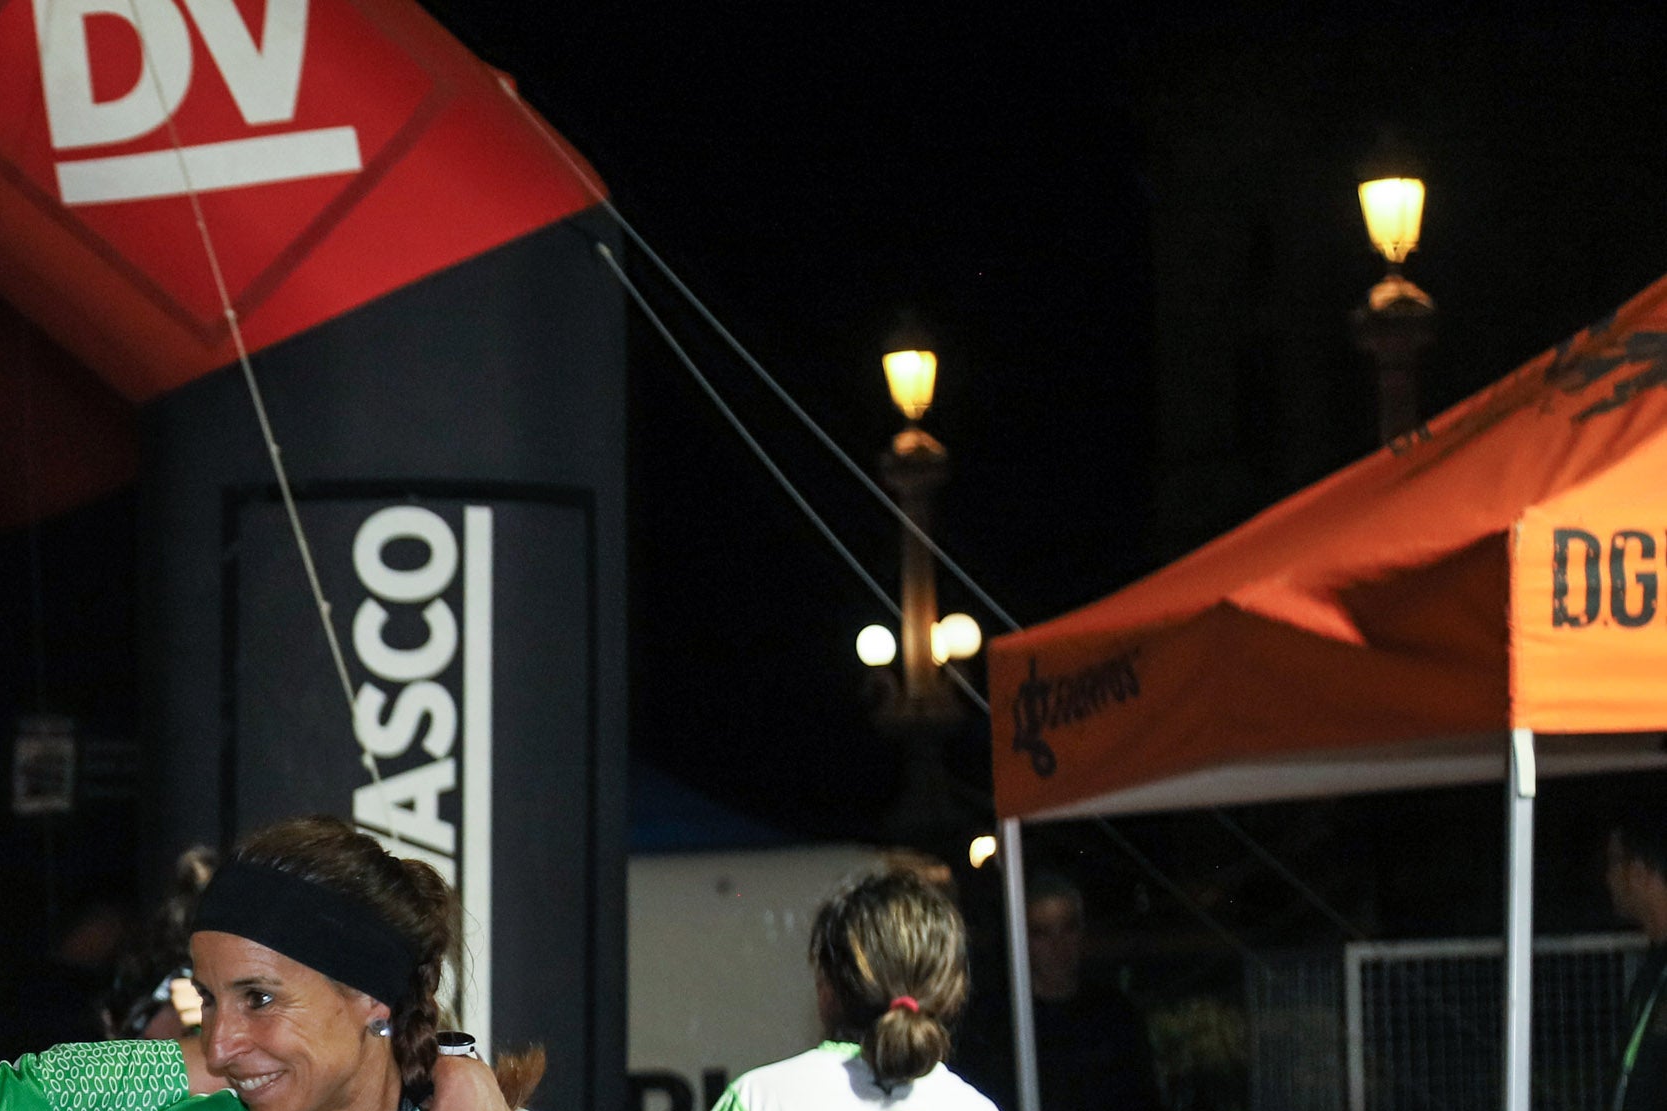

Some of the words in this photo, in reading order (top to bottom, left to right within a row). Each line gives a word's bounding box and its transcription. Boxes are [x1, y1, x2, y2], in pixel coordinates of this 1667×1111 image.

[34, 0, 310, 149] DV
[1553, 528, 1667, 628] DG
[353, 504, 460, 875] ASCO
